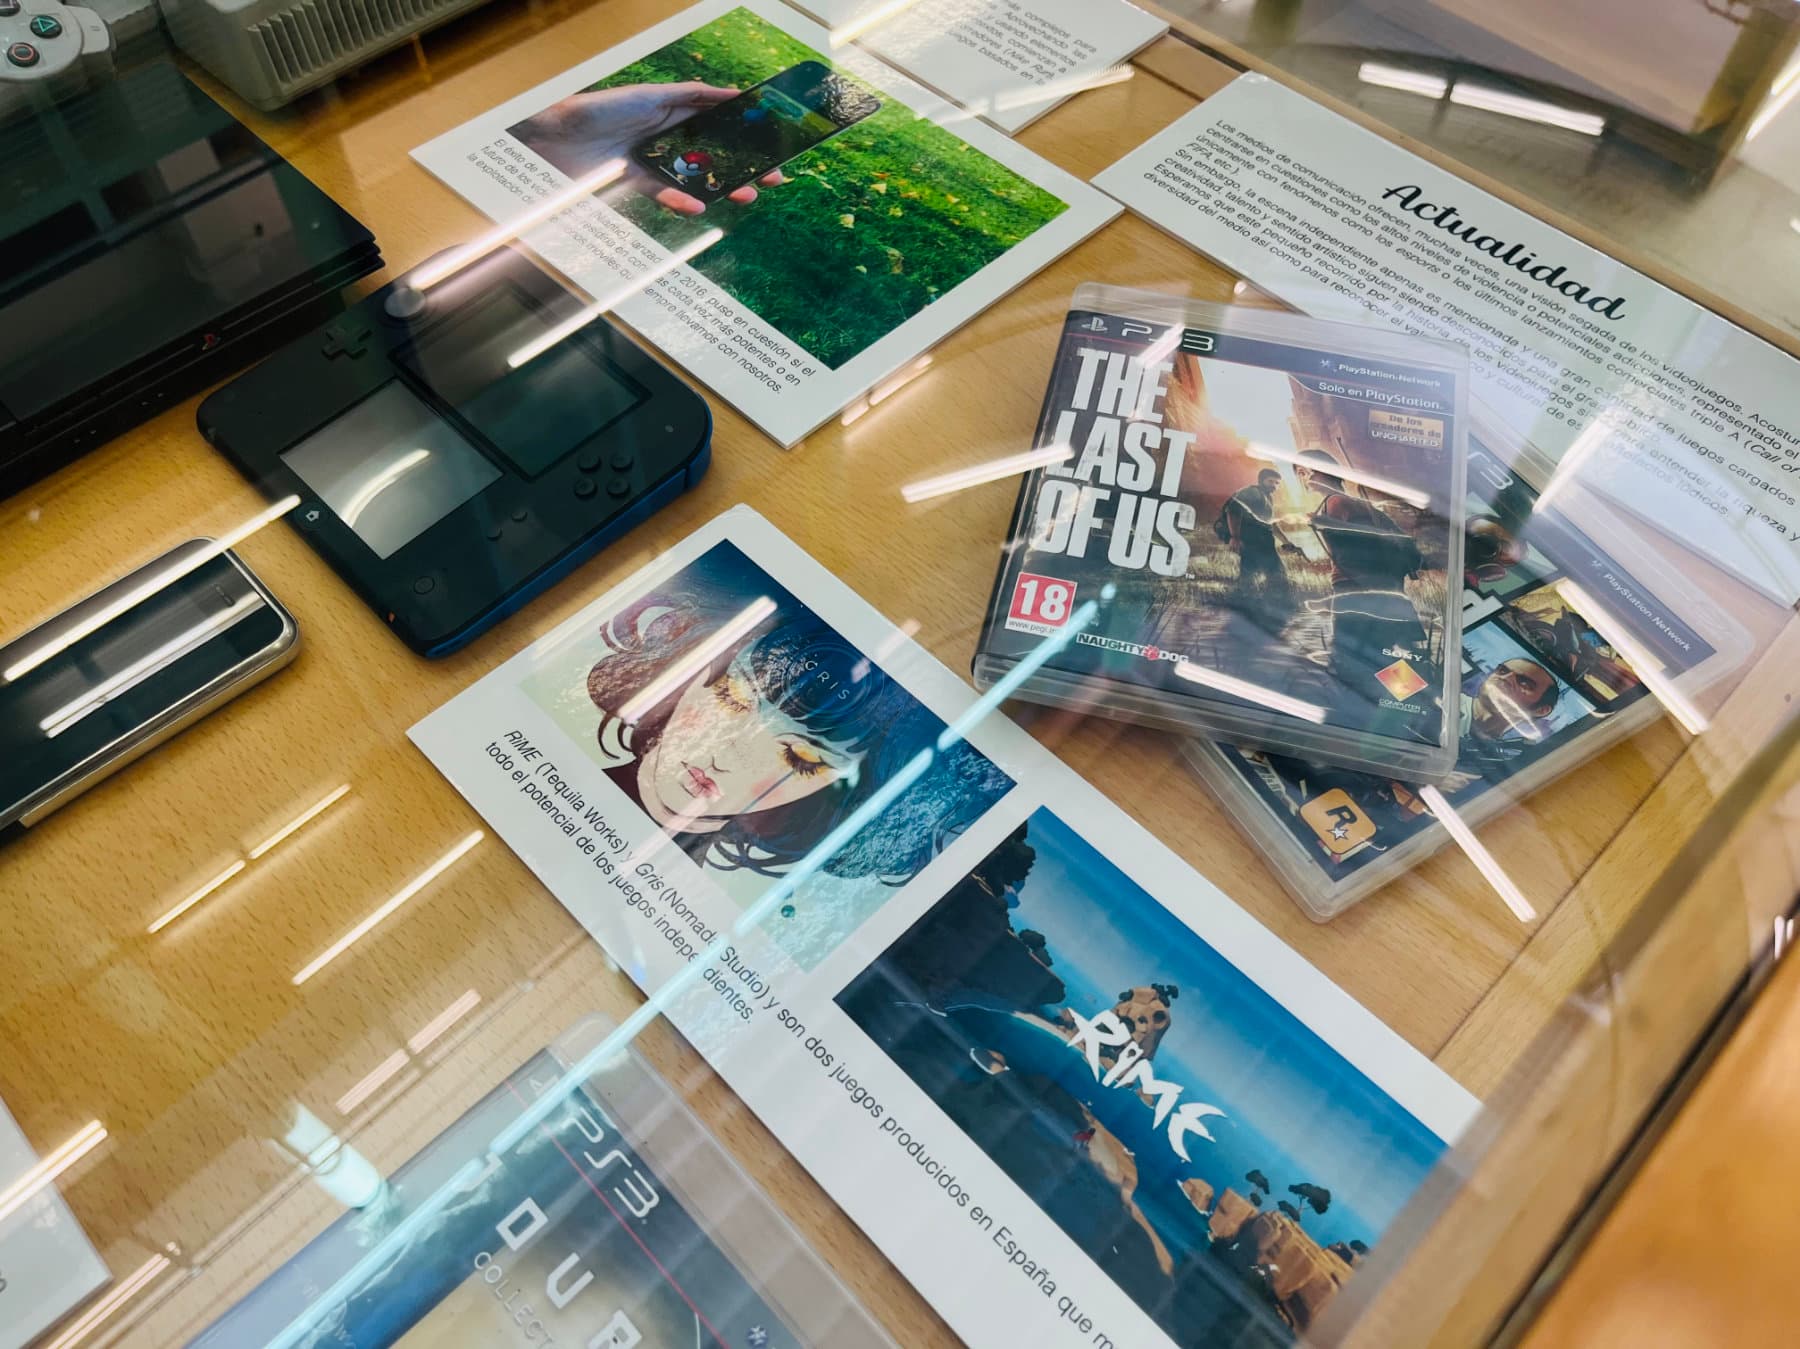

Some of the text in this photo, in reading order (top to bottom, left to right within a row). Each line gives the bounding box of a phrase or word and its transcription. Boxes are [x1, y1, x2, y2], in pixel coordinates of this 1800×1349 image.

[523, 160, 538, 173] de
[704, 297, 733, 318] puso
[732, 316, 748, 329] en
[746, 327, 790, 360] cuestión
[1152, 163, 1212, 200] Esperamos
[1210, 199, 1236, 214] que
[1235, 212, 1261, 229] este
[1259, 228, 1313, 259] pequeño
[1313, 257, 1367, 290] recorrido
[1365, 288, 1390, 303] por
[1163, 157, 1223, 194] creatividad,
[1223, 191, 1262, 215] talento
[1269, 218, 1313, 244] sentido
[1311, 242, 1357, 270] artístico
[1356, 268, 1398, 293] siguen
[1397, 291, 1440, 317] siendo
[1215, 119, 1742, 414] Los medios de comunicación ofrecen, muchas veces, una visión segada de los videojuegos.
[1382, 185, 1625, 320] Actualidad
[666, 285, 693, 305] cada
[692, 304, 712, 319] vez
[710, 318, 734, 336] más
[730, 334, 776, 368] potentes
[784, 373, 800, 386] en
[1122, 321, 1214, 352] P3
[1141, 171, 1199, 206] diversidad
[1196, 203, 1218, 217] del
[1215, 215, 1251, 237] medio
[1249, 235, 1271, 248] así
[1267, 245, 1302, 267] como
[1298, 265, 1330, 283] para
[1328, 281, 1389, 317] reconocer
[1545, 404, 1565, 420] de
[1173, 148, 1193, 161] Sin
[1192, 160, 1241, 191] embargo,
[1256, 196, 1298, 221] escena
[1298, 219, 1378, 267] independiente
[1378, 265, 1425, 293] apenas
[1424, 291, 1442, 303] es
[1442, 301, 1520, 347] mencionada
[1557, 367, 1592, 388] gran
[1654, 419, 1675, 435] de
[1675, 432, 1726, 465] juegos
[1728, 463, 1796, 506] cargados
[1194, 134, 1255, 170] únicamente
[1255, 168, 1279, 183] con
[1278, 180, 1340, 217] fenómenos
[1339, 216, 1374, 236] como
[1374, 233, 1394, 247] los
[1394, 246, 1441, 274] esports
[1451, 276, 1472, 291] los
[1473, 288, 1518, 317] últimos
[1520, 314, 1603, 364] lanzamientos
[1604, 362, 1687, 411] comerciales
[1689, 408, 1725, 433] triple
[1744, 440, 1781, 463] (Call
[1204, 127, 1255, 156] centrarse
[1253, 154, 1271, 165] en
[1269, 163, 1329, 197] cuestiones
[1328, 195, 1362, 216] como
[1361, 212, 1380, 226] los
[1379, 224, 1410, 242] altos
[1409, 240, 1452, 265] niveles
[1451, 262, 1471, 276] de
[1470, 273, 1526, 306] violencia
[1535, 310, 1611, 354] potenciales
[1690, 394, 1783, 450] representado
[675, 310, 718, 344] llevamos
[717, 342, 738, 359] con
[736, 357, 781, 393] nosotros.
[1071, 348, 1174, 424] THE
[1318, 382, 1440, 409] Solo en PlayStation
[1044, 410, 1197, 498] LAST
[1030, 480, 1196, 577] OF US
[1020, 579, 1069, 621] 18
[1078, 633, 1189, 664] NAUGHTY DOG
[1603, 573, 1691, 652] PlayStation Network
[805, 660, 850, 700] GRIS
[1382, 648, 1422, 662] SONY
[485, 741, 755, 1021] todo el potencial de los juegos indepedientes.
[533, 760, 587, 810] (Tequila
[582, 805, 632, 854] Works)
[635, 860, 665, 890] Gris
[719, 945, 773, 999] Studio)
[761, 996, 780, 1011] y
[777, 1008, 807, 1036] son
[804, 1034, 836, 1066] dos
[827, 1062, 885, 1117] juegos
[877, 1116, 973, 1206] producidos
[968, 1205, 996, 1229] en
[992, 1226, 1060, 1295] España
[1058, 1296, 1092, 1333] que
[562, 1107, 660, 1218] PS3
